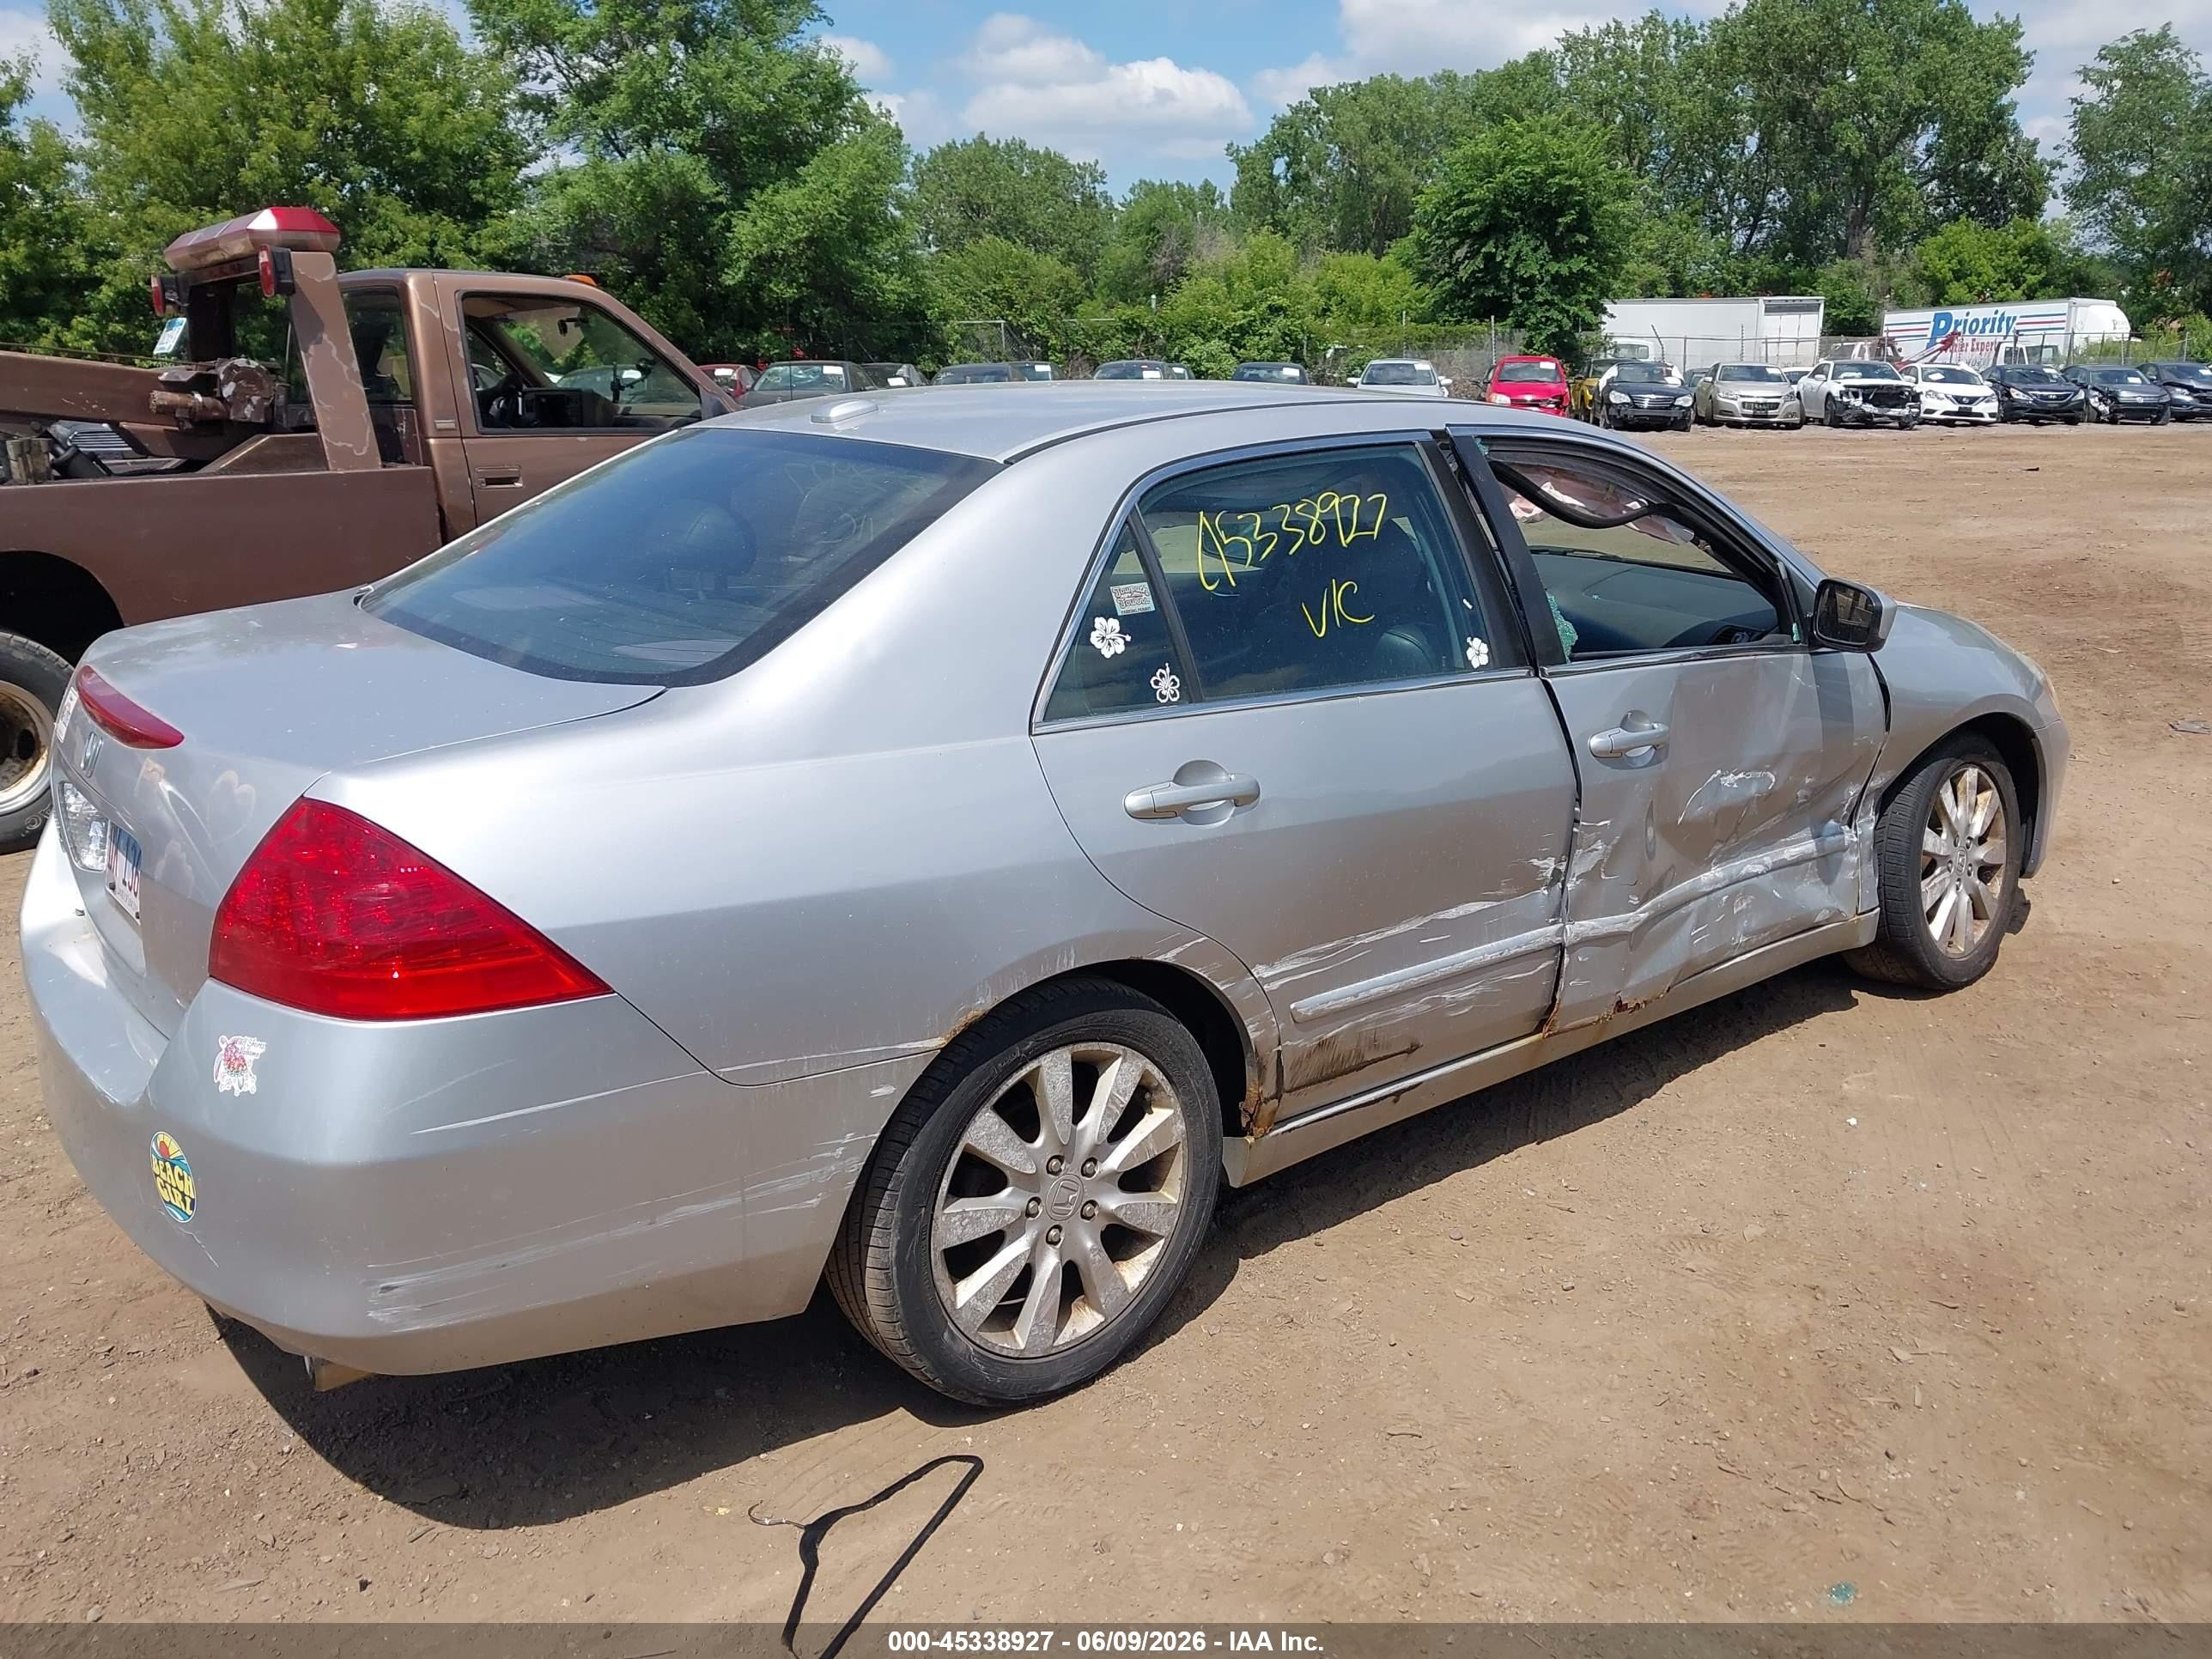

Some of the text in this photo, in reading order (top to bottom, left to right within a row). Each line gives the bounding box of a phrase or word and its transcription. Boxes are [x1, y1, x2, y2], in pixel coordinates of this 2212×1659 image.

[1926, 309, 2017, 350] Priority
[1302, 579, 1376, 638] VIC
[151, 1154, 195, 1199] BEACH
[156, 1176, 193, 1215] GIRL
